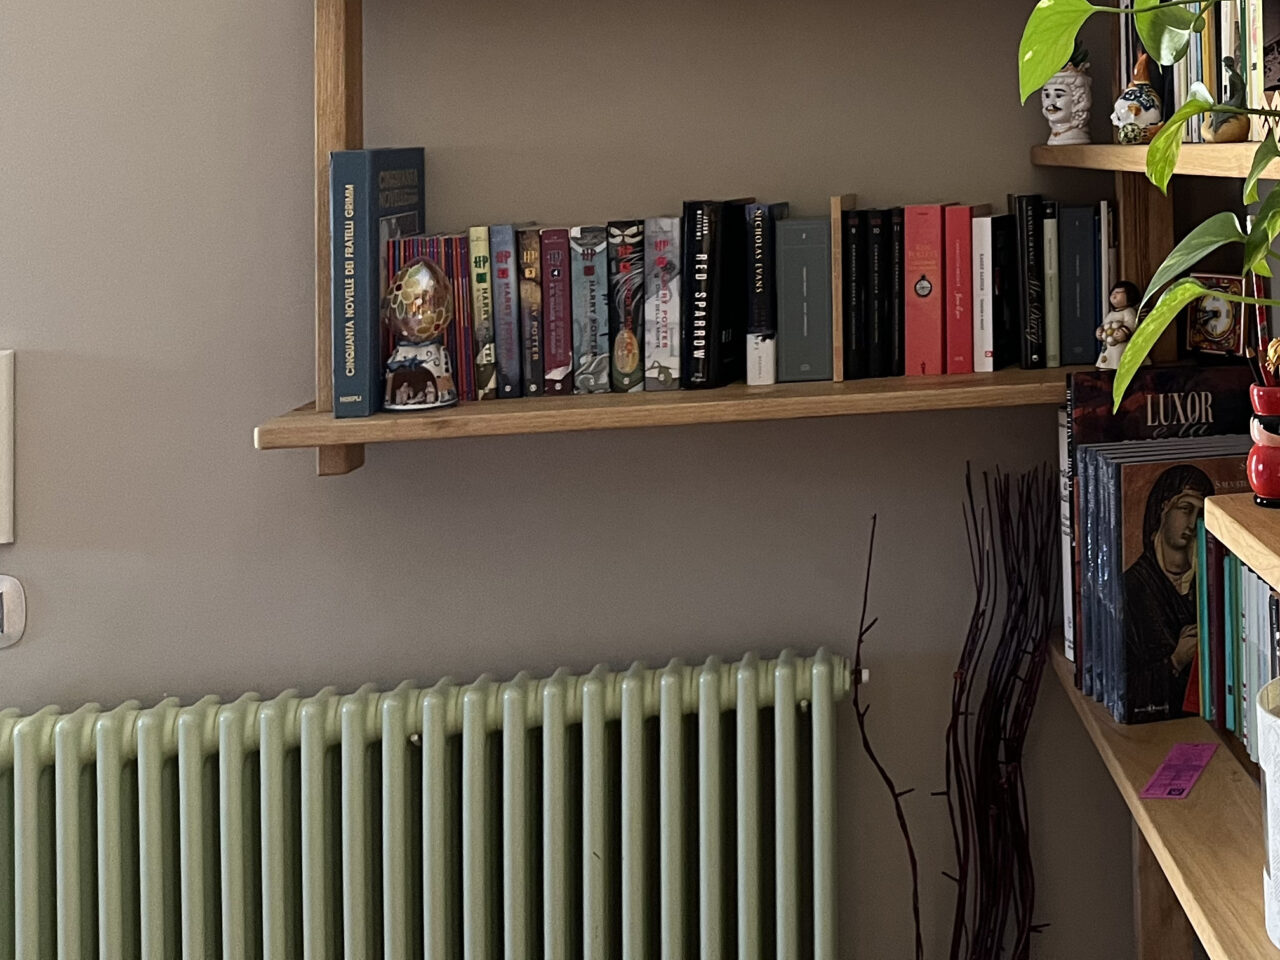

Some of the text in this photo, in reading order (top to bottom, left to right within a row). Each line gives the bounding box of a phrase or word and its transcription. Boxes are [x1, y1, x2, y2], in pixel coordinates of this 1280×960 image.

[753, 209, 763, 260] NICHOLAS
[344, 184, 355, 377] CINQUANTA NOVELLE DEI FRATELLI GRIMM
[754, 263, 764, 293] EVANS
[482, 287, 491, 321] HARRY
[589, 280, 599, 357] HARRY POTTER
[693, 253, 708, 359] RED SPARROW
[531, 321, 540, 361] POTTER
[1146, 391, 1215, 426] LUXOR
